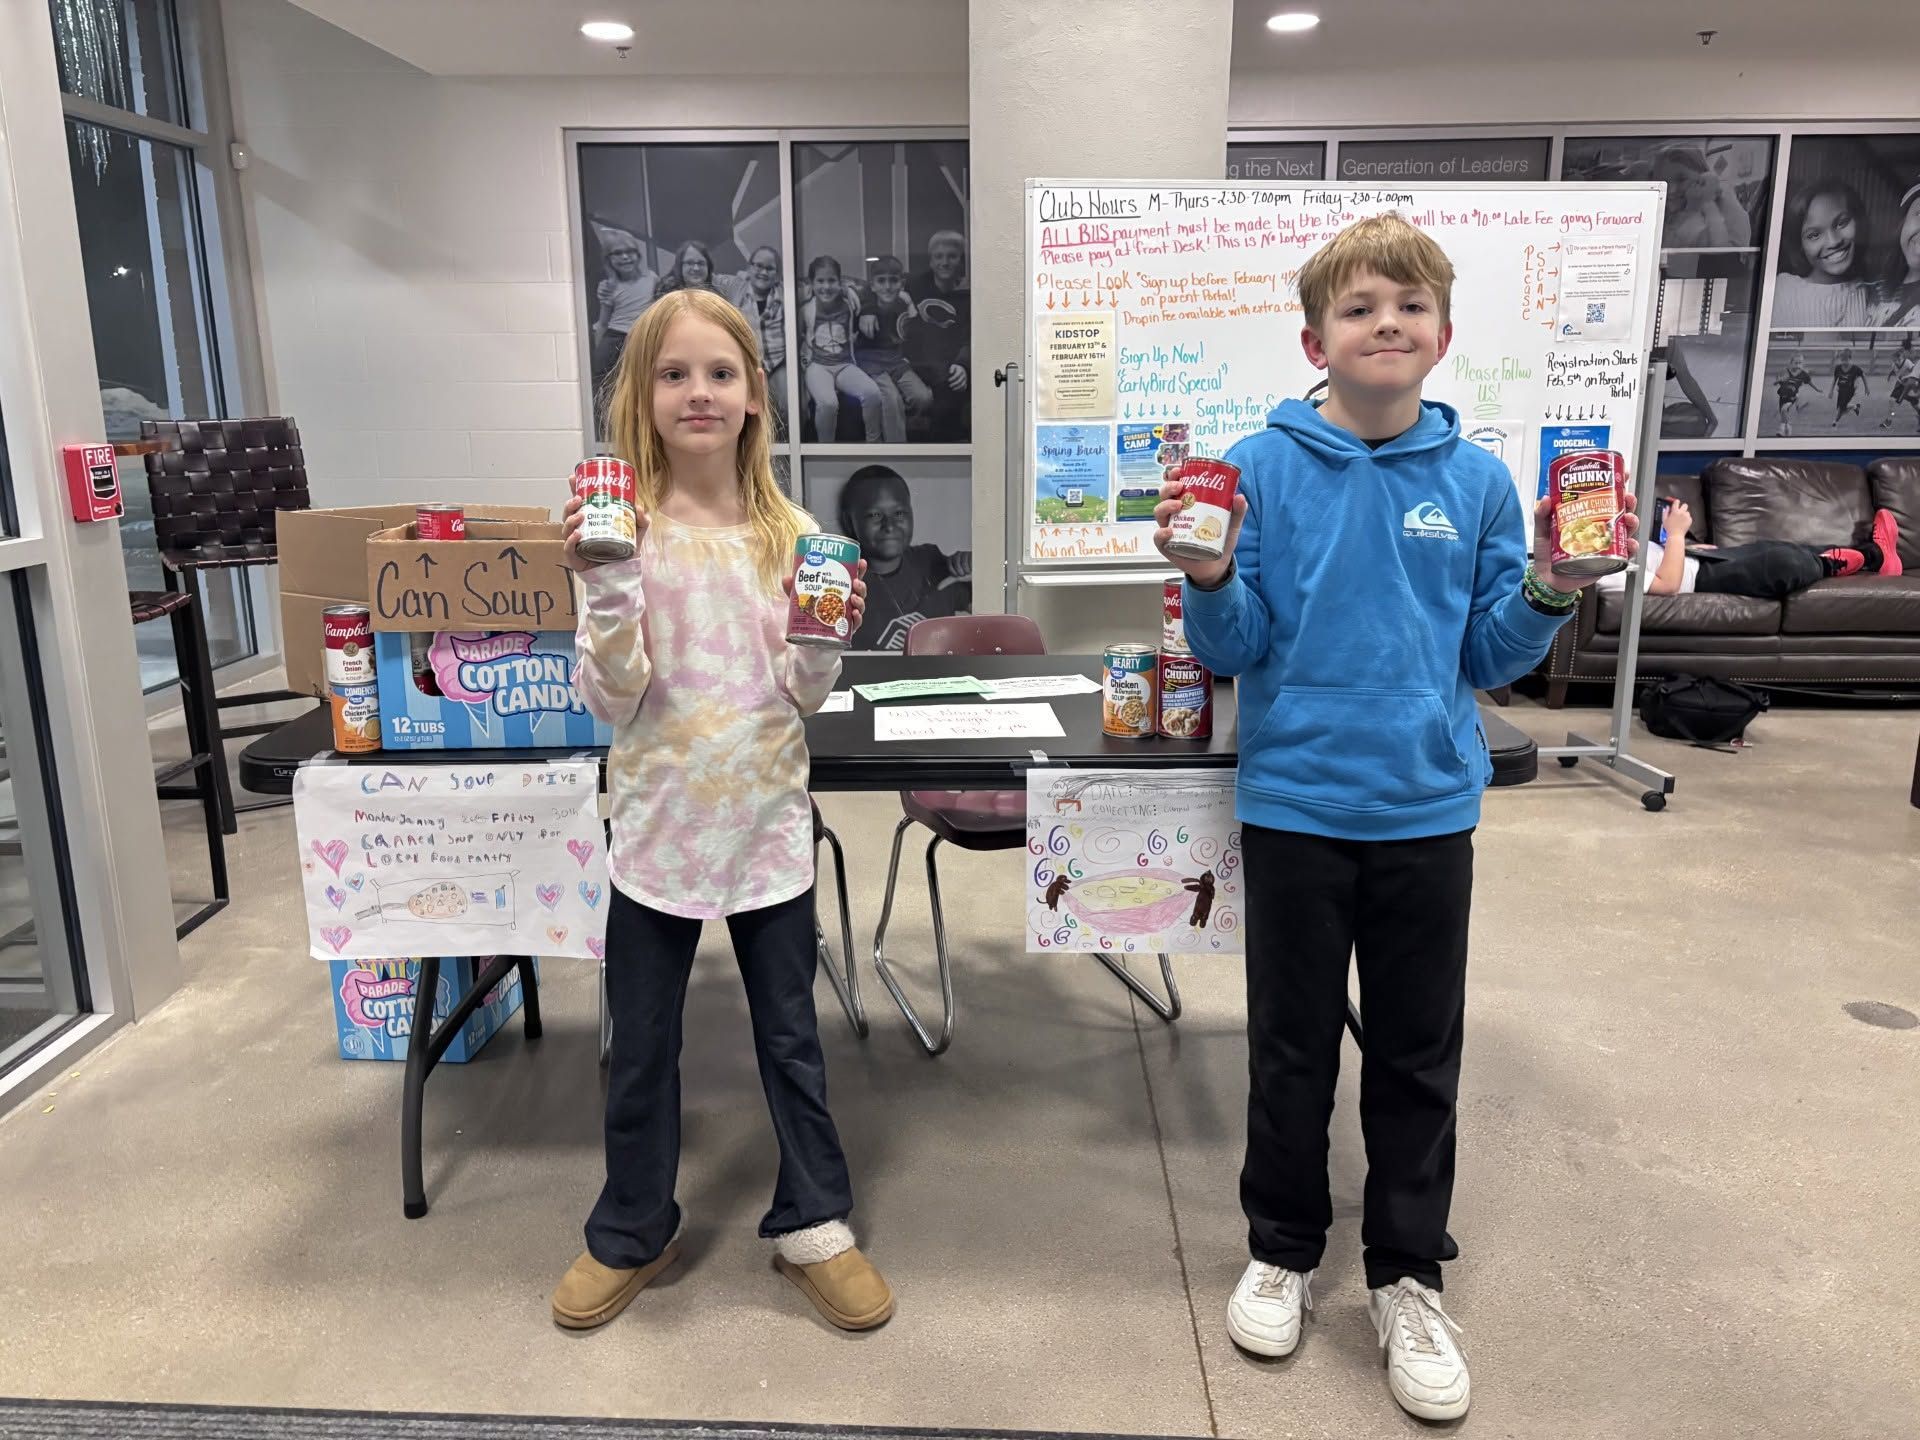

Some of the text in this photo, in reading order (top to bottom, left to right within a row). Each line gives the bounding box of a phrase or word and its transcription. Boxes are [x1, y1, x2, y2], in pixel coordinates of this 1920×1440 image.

[1245, 154, 1529, 176] the Next Generation of Leaders
[1039, 189, 1083, 221] Club
[1088, 189, 1138, 217] Hours
[1112, 221, 1171, 247] payment
[1177, 216, 1207, 236] must
[1214, 216, 1231, 233] be
[1235, 216, 1273, 233] made
[1278, 214, 1295, 241] by
[1299, 212, 1322, 228] the
[1411, 209, 1435, 226] will
[1440, 210, 1456, 226] be
[1460, 214, 1468, 224] a
[1504, 210, 1532, 225] Late
[1535, 210, 1553, 225] Fee
[1559, 213, 1593, 233] going
[1596, 211, 1643, 226] Forward
[1041, 249, 1083, 265] Please
[1089, 251, 1114, 268] pay
[1115, 241, 1130, 256] at
[1213, 234, 1241, 249] This
[1037, 272, 1092, 290] Please
[1169, 278, 1189, 293] up
[1191, 271, 1228, 287] before
[1233, 270, 1276, 292] Febuary
[1140, 296, 1155, 306] on
[1159, 289, 1200, 310] parent
[1162, 309, 1176, 321] Fee
[1178, 306, 1226, 320] available
[1228, 303, 1251, 316] with
[1252, 300, 1281, 314] extra
[1055, 328, 1100, 339] KIDSTOP
[1050, 342, 1086, 350] FEBRUARY
[1119, 347, 1149, 370] Sign
[1152, 345, 1168, 369] Up
[1545, 349, 1638, 377] Registration Starts
[1455, 354, 1532, 381] Please Follow
[1584, 376, 1597, 388] on
[1598, 371, 1624, 386] Parent
[1245, 396, 1263, 417] for
[1195, 419, 1265, 436] and receive
[1466, 426, 1495, 439] DUNELAND
[1041, 445, 1073, 458] Spring
[1123, 439, 1151, 450] CAMP
[1553, 438, 1597, 448] DODGEBALL
[85, 448, 112, 465] FIRE
[575, 470, 632, 491] Campbell's
[1560, 470, 1612, 488] CHUNKY
[1558, 500, 1589, 518] CREAMY
[1173, 515, 1196, 523] Chicken
[811, 539, 845, 557] HEARTY
[1034, 541, 1058, 557] Now
[1060, 545, 1075, 556] on
[1076, 538, 1110, 556] Parent
[798, 570, 822, 583] Beef
[821, 576, 850, 589] Vegetables
[376, 560, 450, 620] Can
[461, 560, 555, 625] Soup
[457, 637, 525, 661] PARADE
[1112, 657, 1141, 669] HEARTY
[461, 657, 565, 690] COTTON
[1164, 668, 1201, 681] CHUNKY
[1110, 679, 1139, 689] Chicken
[391, 716, 446, 734] 12 TUBS
[360, 771, 429, 795] CAN
[522, 771, 577, 788] DRIVE
[359, 981, 407, 998] PARADE
[363, 998, 417, 1018] COTTO
